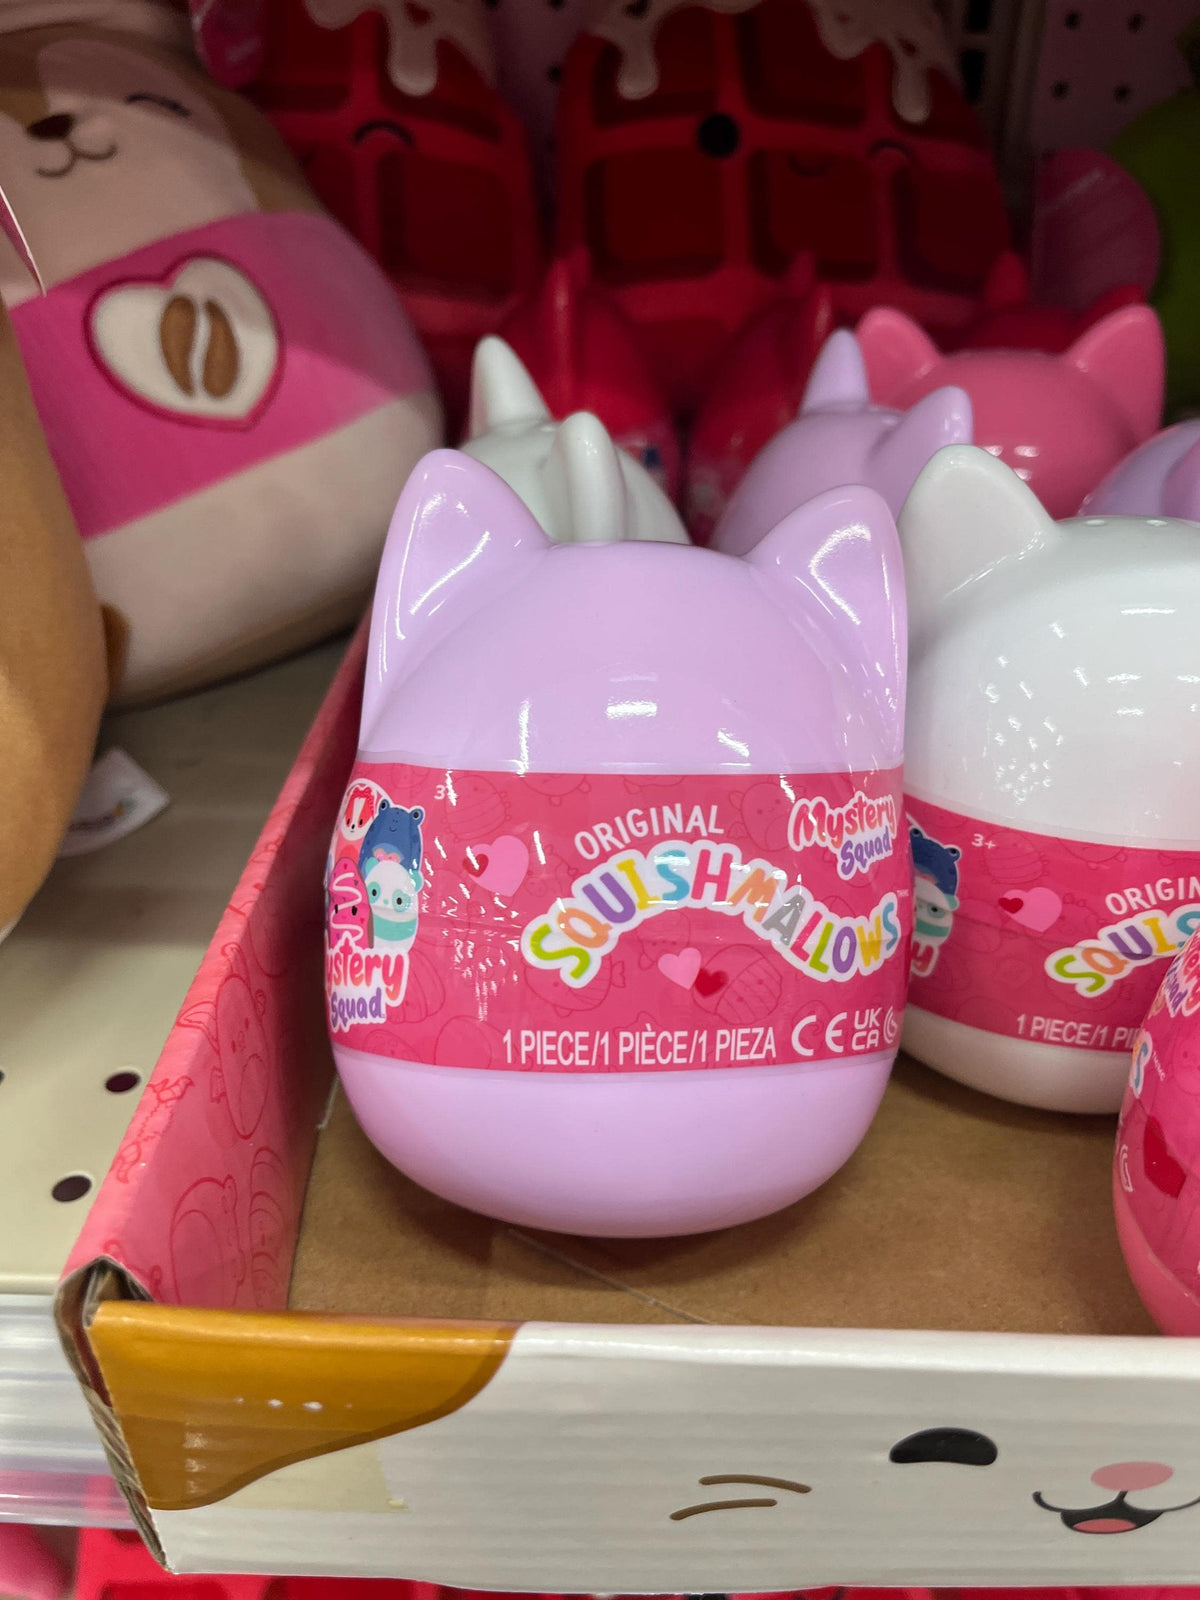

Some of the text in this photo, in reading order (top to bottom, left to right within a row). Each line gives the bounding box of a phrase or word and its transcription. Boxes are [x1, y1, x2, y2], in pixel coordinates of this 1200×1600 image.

[575, 803, 724, 859] ORIGINAL
[793, 795, 896, 849] Mystery
[971, 833, 996, 849] 3+
[840, 826, 891, 875] Squad
[528, 847, 898, 981] SQUISHMALLOWS
[326, 937, 405, 1001] ystery
[331, 987, 382, 1028] Squad
[1017, 1014, 1027, 1035] 1
[1030, 1016, 1109, 1046] PIECE/1
[503, 1023, 777, 1066] 1 PIECE/1 PIÈCE/1 PIEZA
